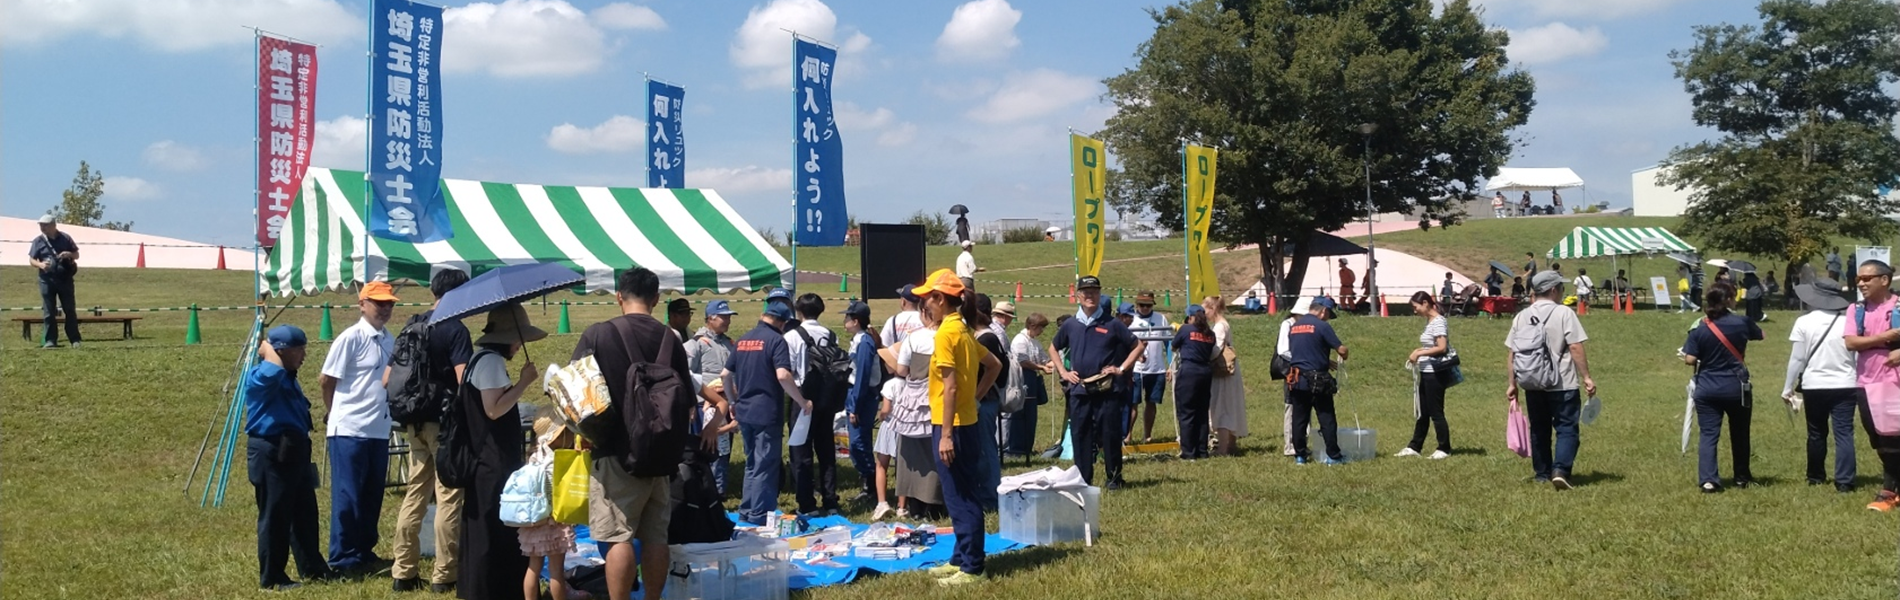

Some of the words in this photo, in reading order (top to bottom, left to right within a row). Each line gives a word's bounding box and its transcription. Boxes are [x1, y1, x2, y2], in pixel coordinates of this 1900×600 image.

[267, 48, 294, 239] 埼玉県防災士会
[385, 8, 418, 236] 埼玉県防災士会
[417, 17, 434, 166] 特定非営利活動法人
[1193, 156, 1207, 296] ロープワー
